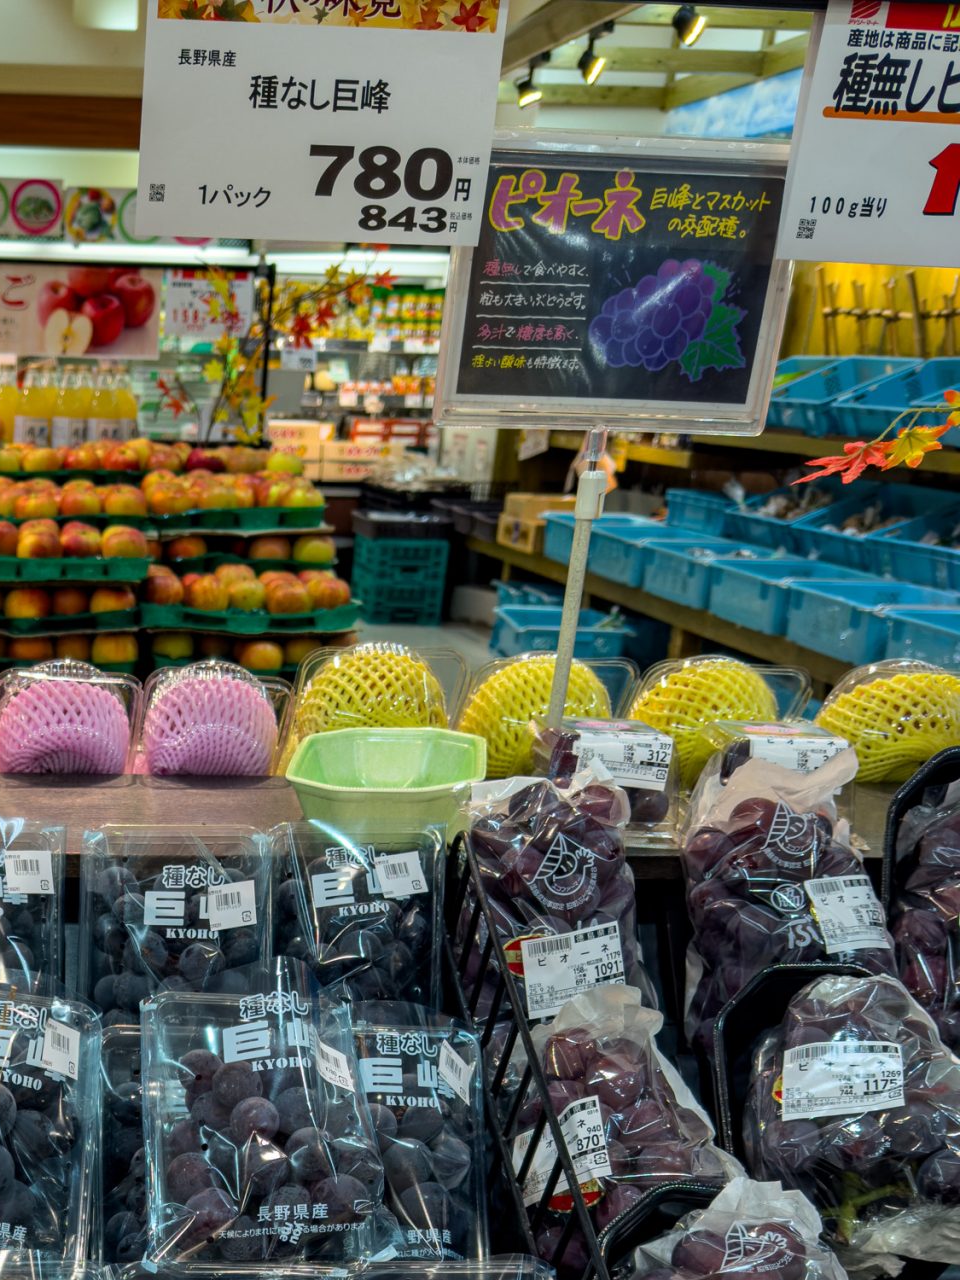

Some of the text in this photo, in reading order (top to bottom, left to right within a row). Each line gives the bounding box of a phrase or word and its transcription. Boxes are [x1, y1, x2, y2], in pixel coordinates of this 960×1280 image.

[847, 29, 960, 52] 産地は商品に記
[178, 48, 237, 68] 長野県産
[249, 75, 391, 114] 種なし巨峰
[309, 144, 471, 202] 780 円
[198, 185, 271, 208] 1パック
[489, 168, 646, 241] ピオーネ
[650, 183, 770, 211] 巨峰とマスカット
[809, 196, 888, 219] 100g当り
[358, 205, 447, 233] 843
[647, 750, 668, 763] 312
[162, 864, 226, 889] 種なし
[143, 890, 212, 927] 巨
[338, 901, 390, 917] KYOHO
[165, 926, 219, 941] KYOHO
[594, 960, 620, 978] 1091
[240, 991, 309, 1019] 種なし
[376, 1033, 438, 1057] 種なし
[251, 1055, 313, 1072] KYOHO
[385, 1095, 440, 1108] KYOHO
[576, 1134, 600, 1151] 870
[257, 1203, 329, 1222] 長野県産
